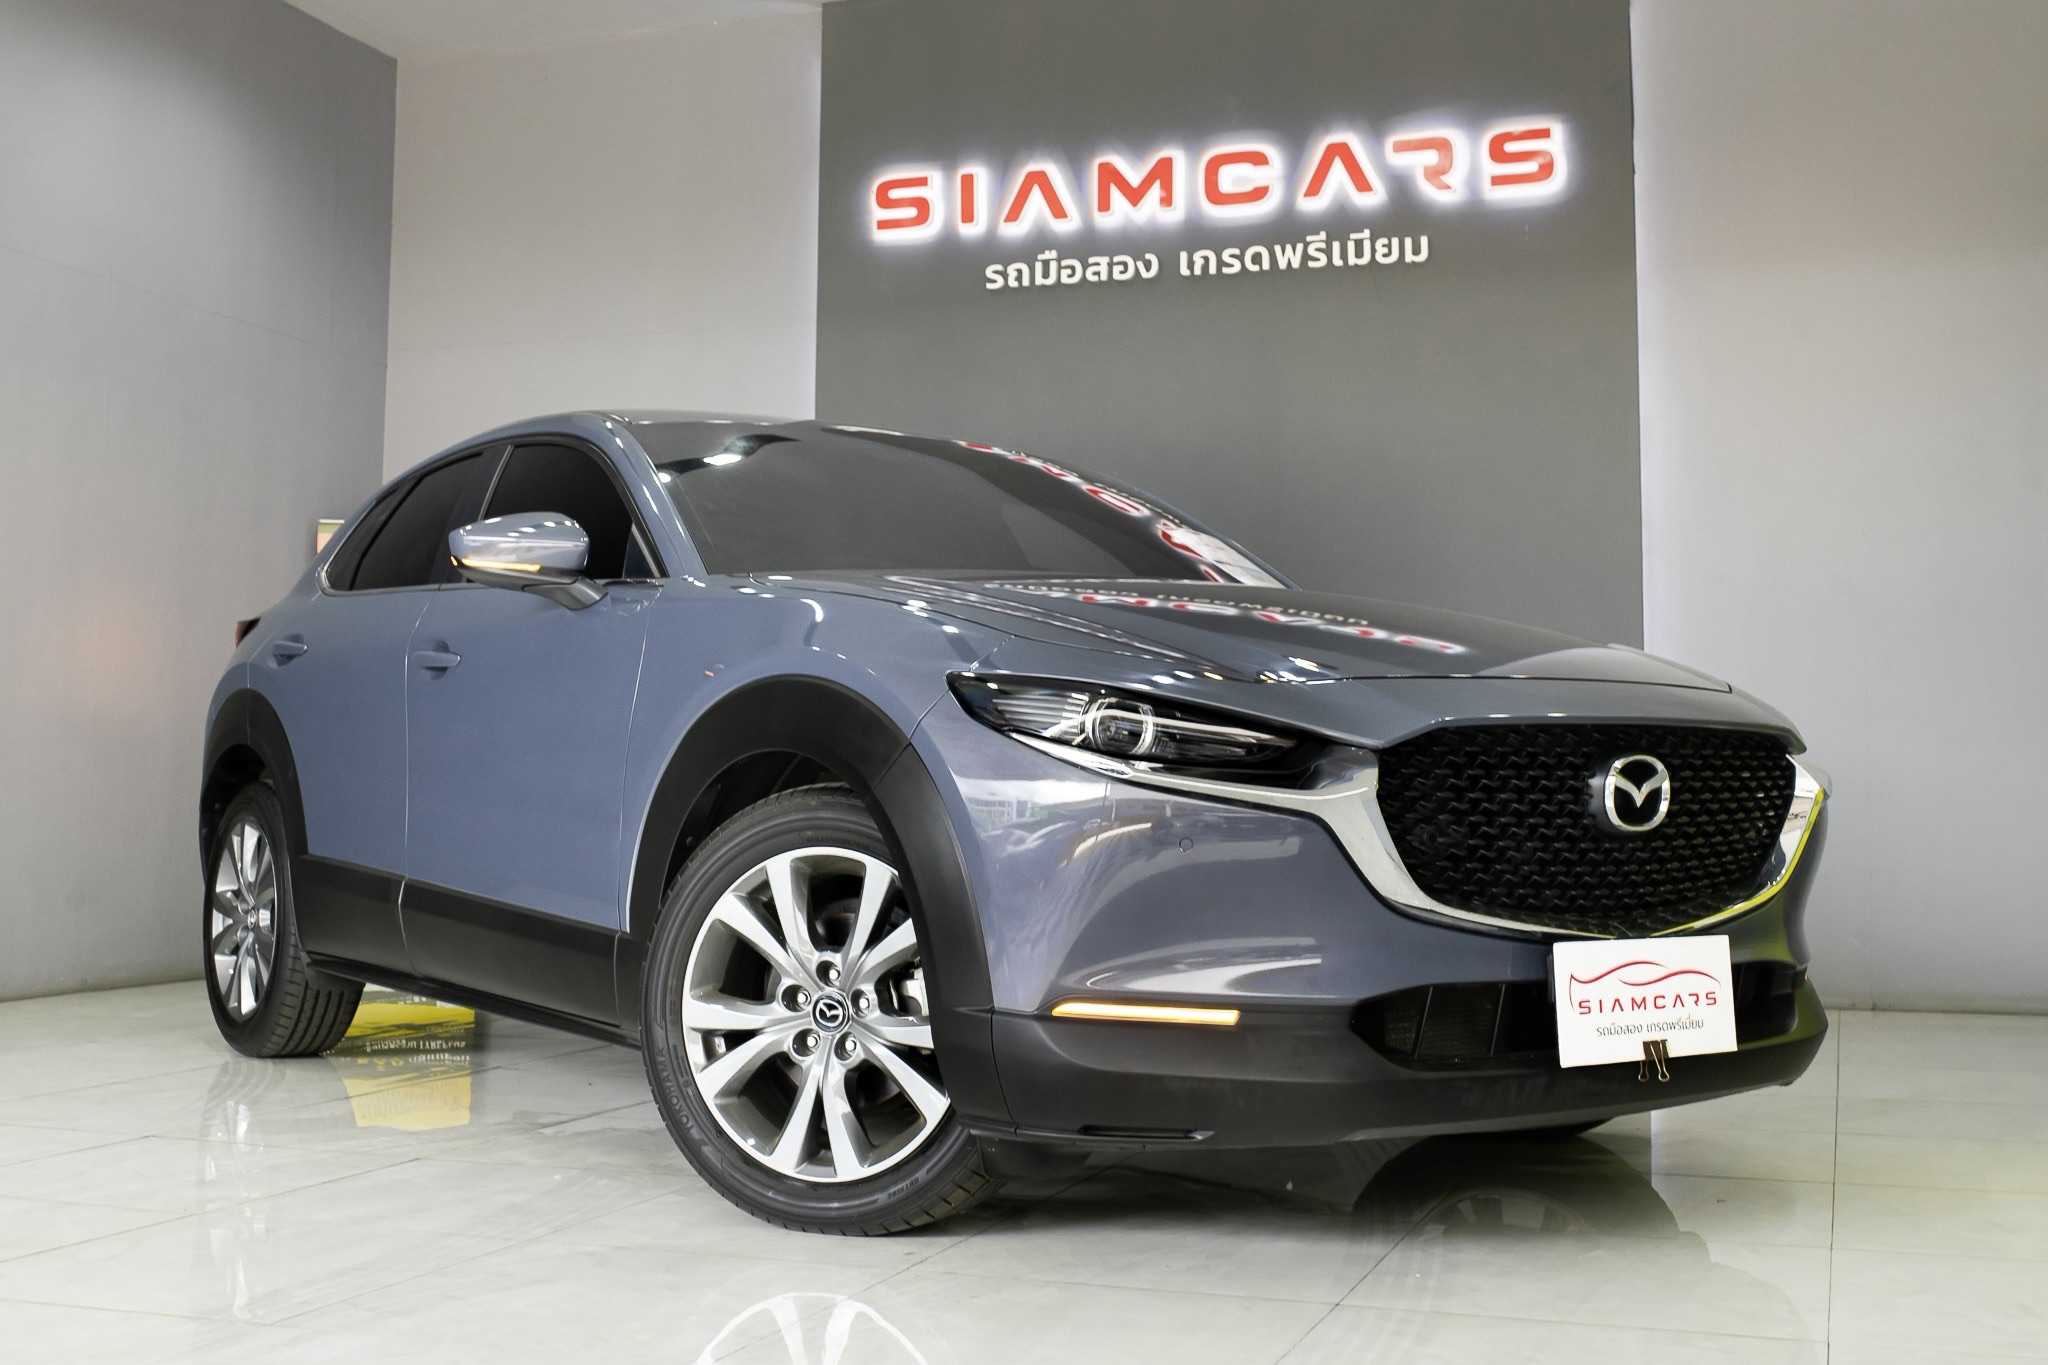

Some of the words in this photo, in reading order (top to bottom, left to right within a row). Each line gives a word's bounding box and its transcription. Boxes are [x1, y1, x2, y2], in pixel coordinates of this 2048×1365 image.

[872, 124, 1557, 233] SIAMCARS
[985, 249, 1159, 290] รถมือสอง
[1179, 228, 1430, 277] เกรดพรีเมียม
[1578, 991, 1718, 1015] SIAMCARS
[655, 1047, 695, 1135] YOKOHAMA
